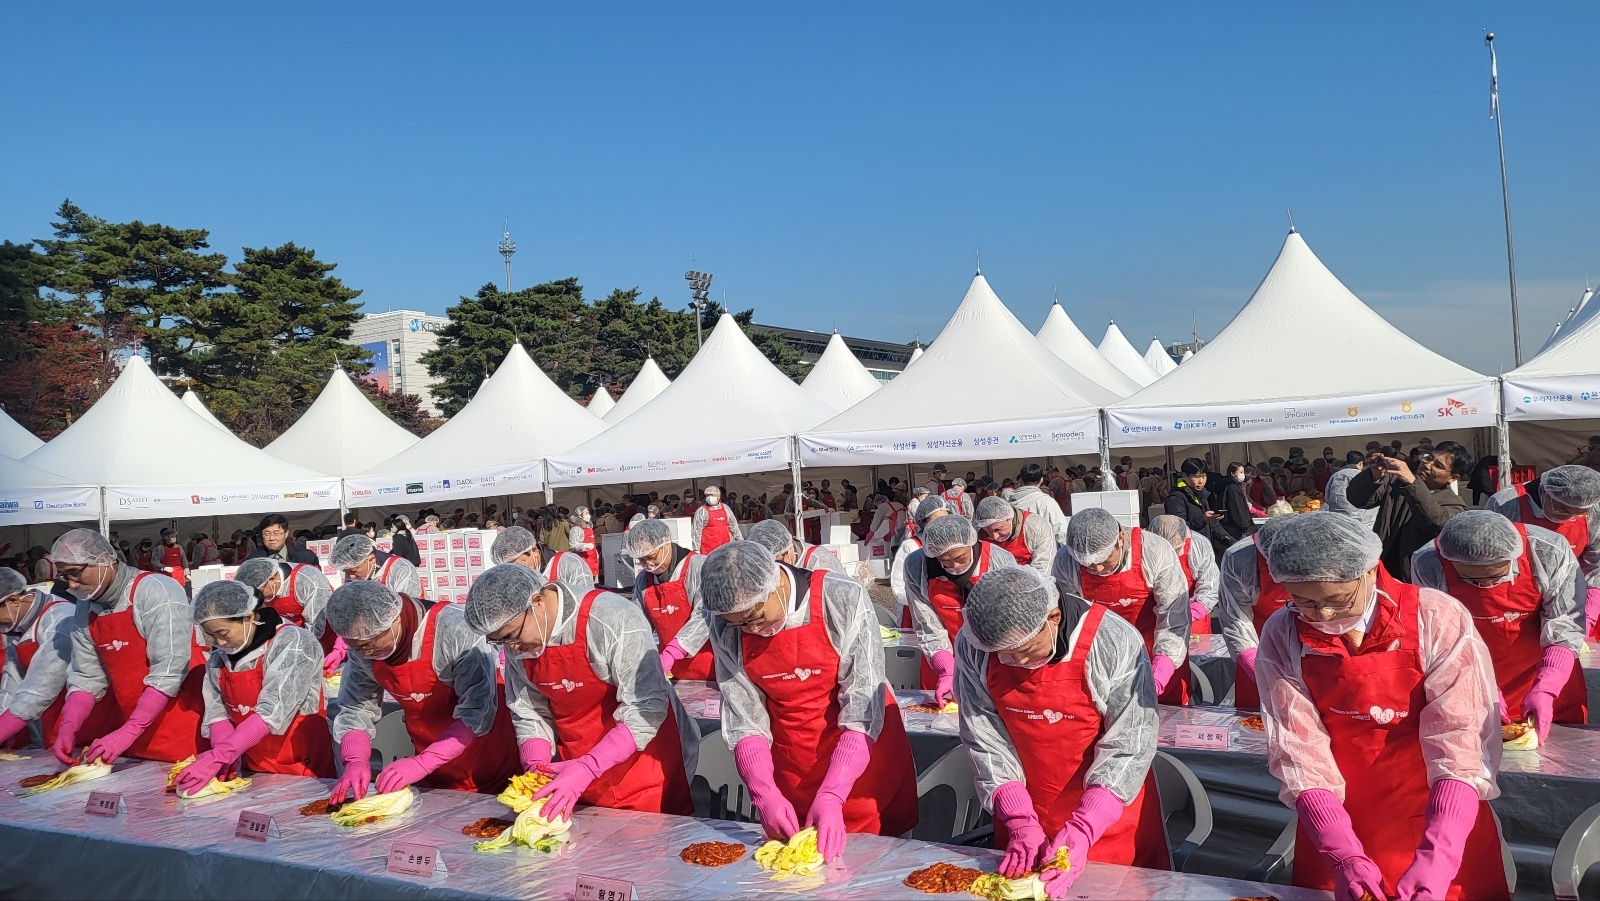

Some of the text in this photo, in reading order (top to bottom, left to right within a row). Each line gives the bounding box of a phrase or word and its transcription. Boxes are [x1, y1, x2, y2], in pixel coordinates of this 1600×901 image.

[1533, 394, 1573, 402] 우리자산운용
[1438, 407, 1478, 417] SK 증권
[1051, 431, 1085, 439] Schroders
[893, 442, 917, 450] 삼성선물
[927, 439, 963, 449] 삼성자산운용
[973, 436, 1000, 446] 삼성증권
[0, 500, 19, 508] aiwa
[408, 854, 431, 866] 손병두
[598, 889, 625, 901] 황영기
